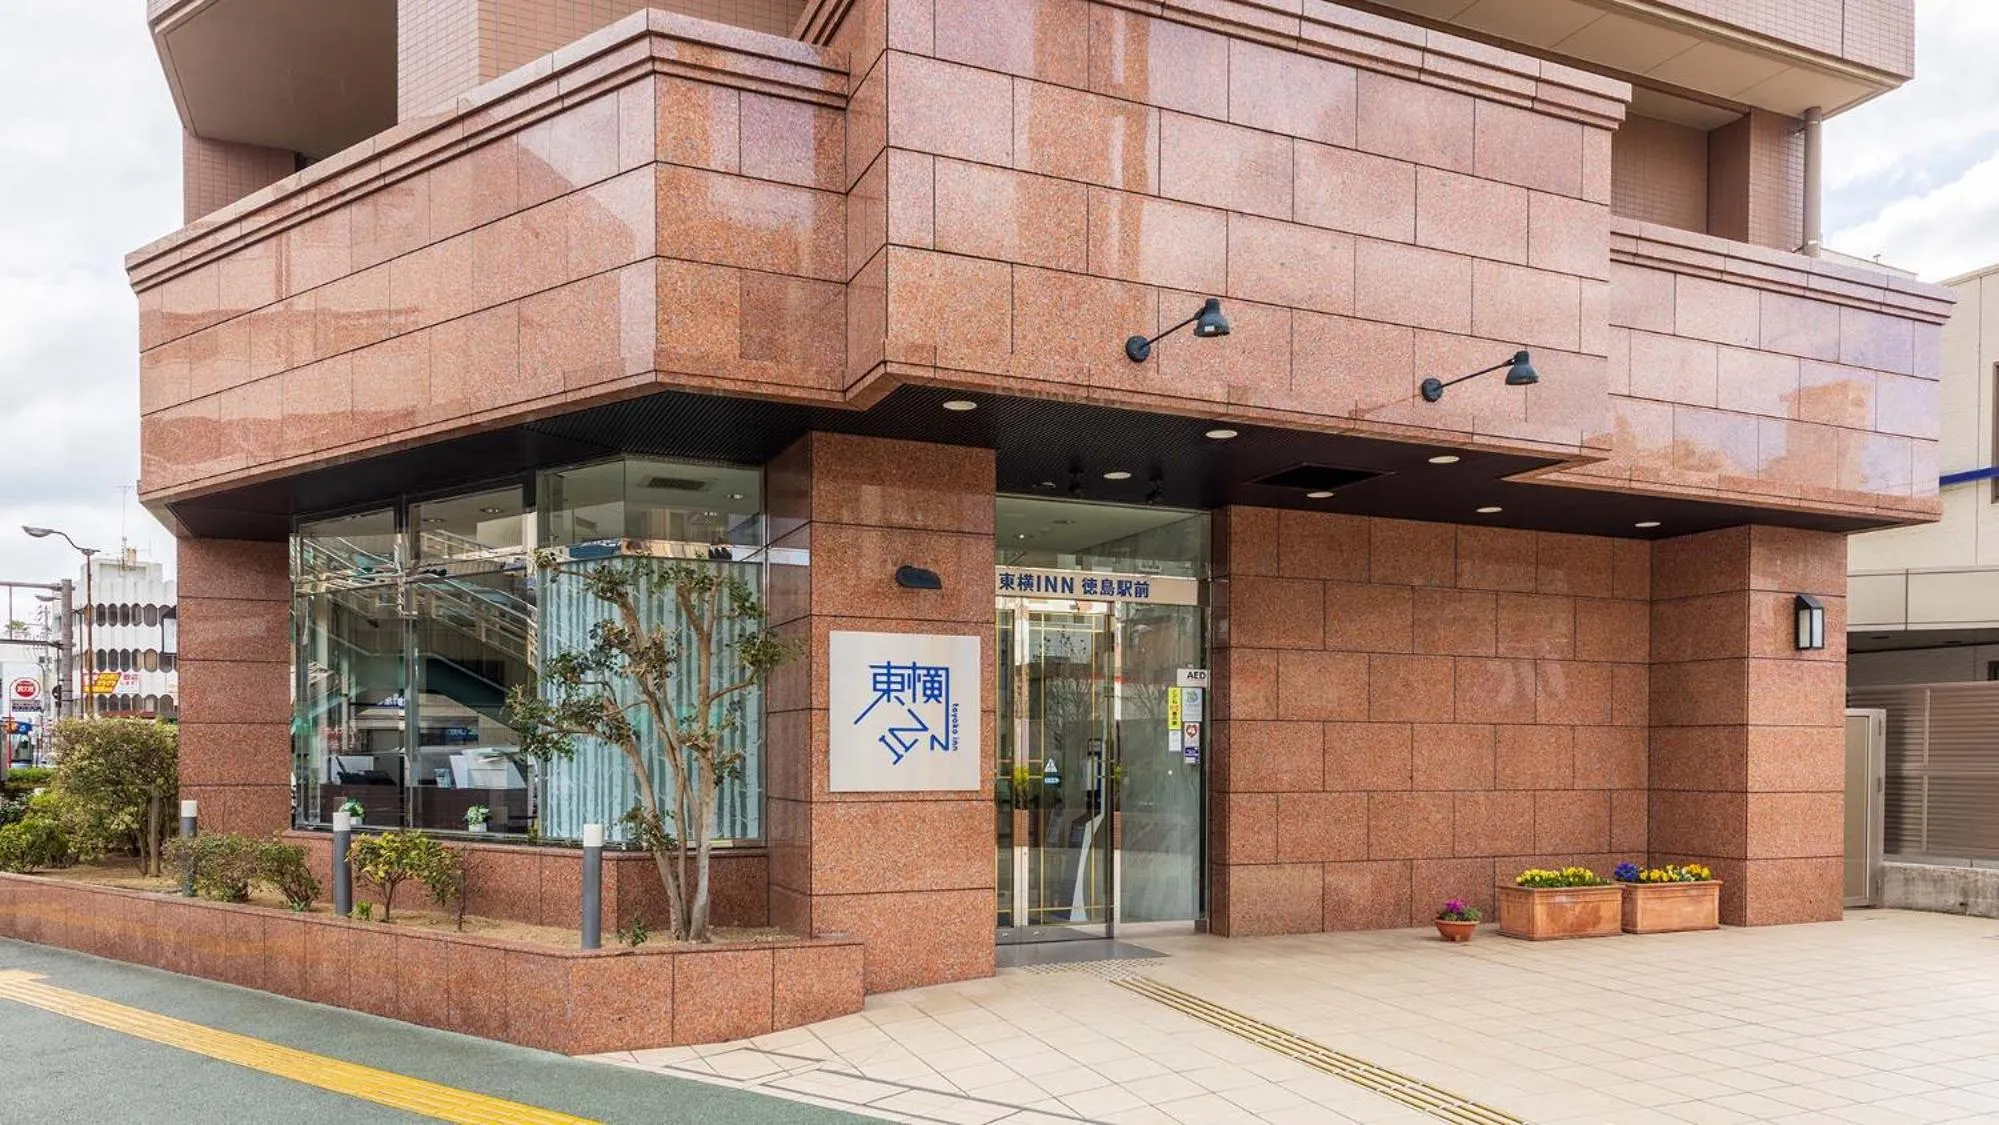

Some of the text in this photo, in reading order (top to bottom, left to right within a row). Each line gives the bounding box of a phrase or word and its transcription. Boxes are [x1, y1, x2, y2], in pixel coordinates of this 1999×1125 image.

[999, 573, 1150, 598] 東横INN 徳島駅前
[1187, 671, 1206, 680] AED
[951, 703, 959, 734] toyoko
